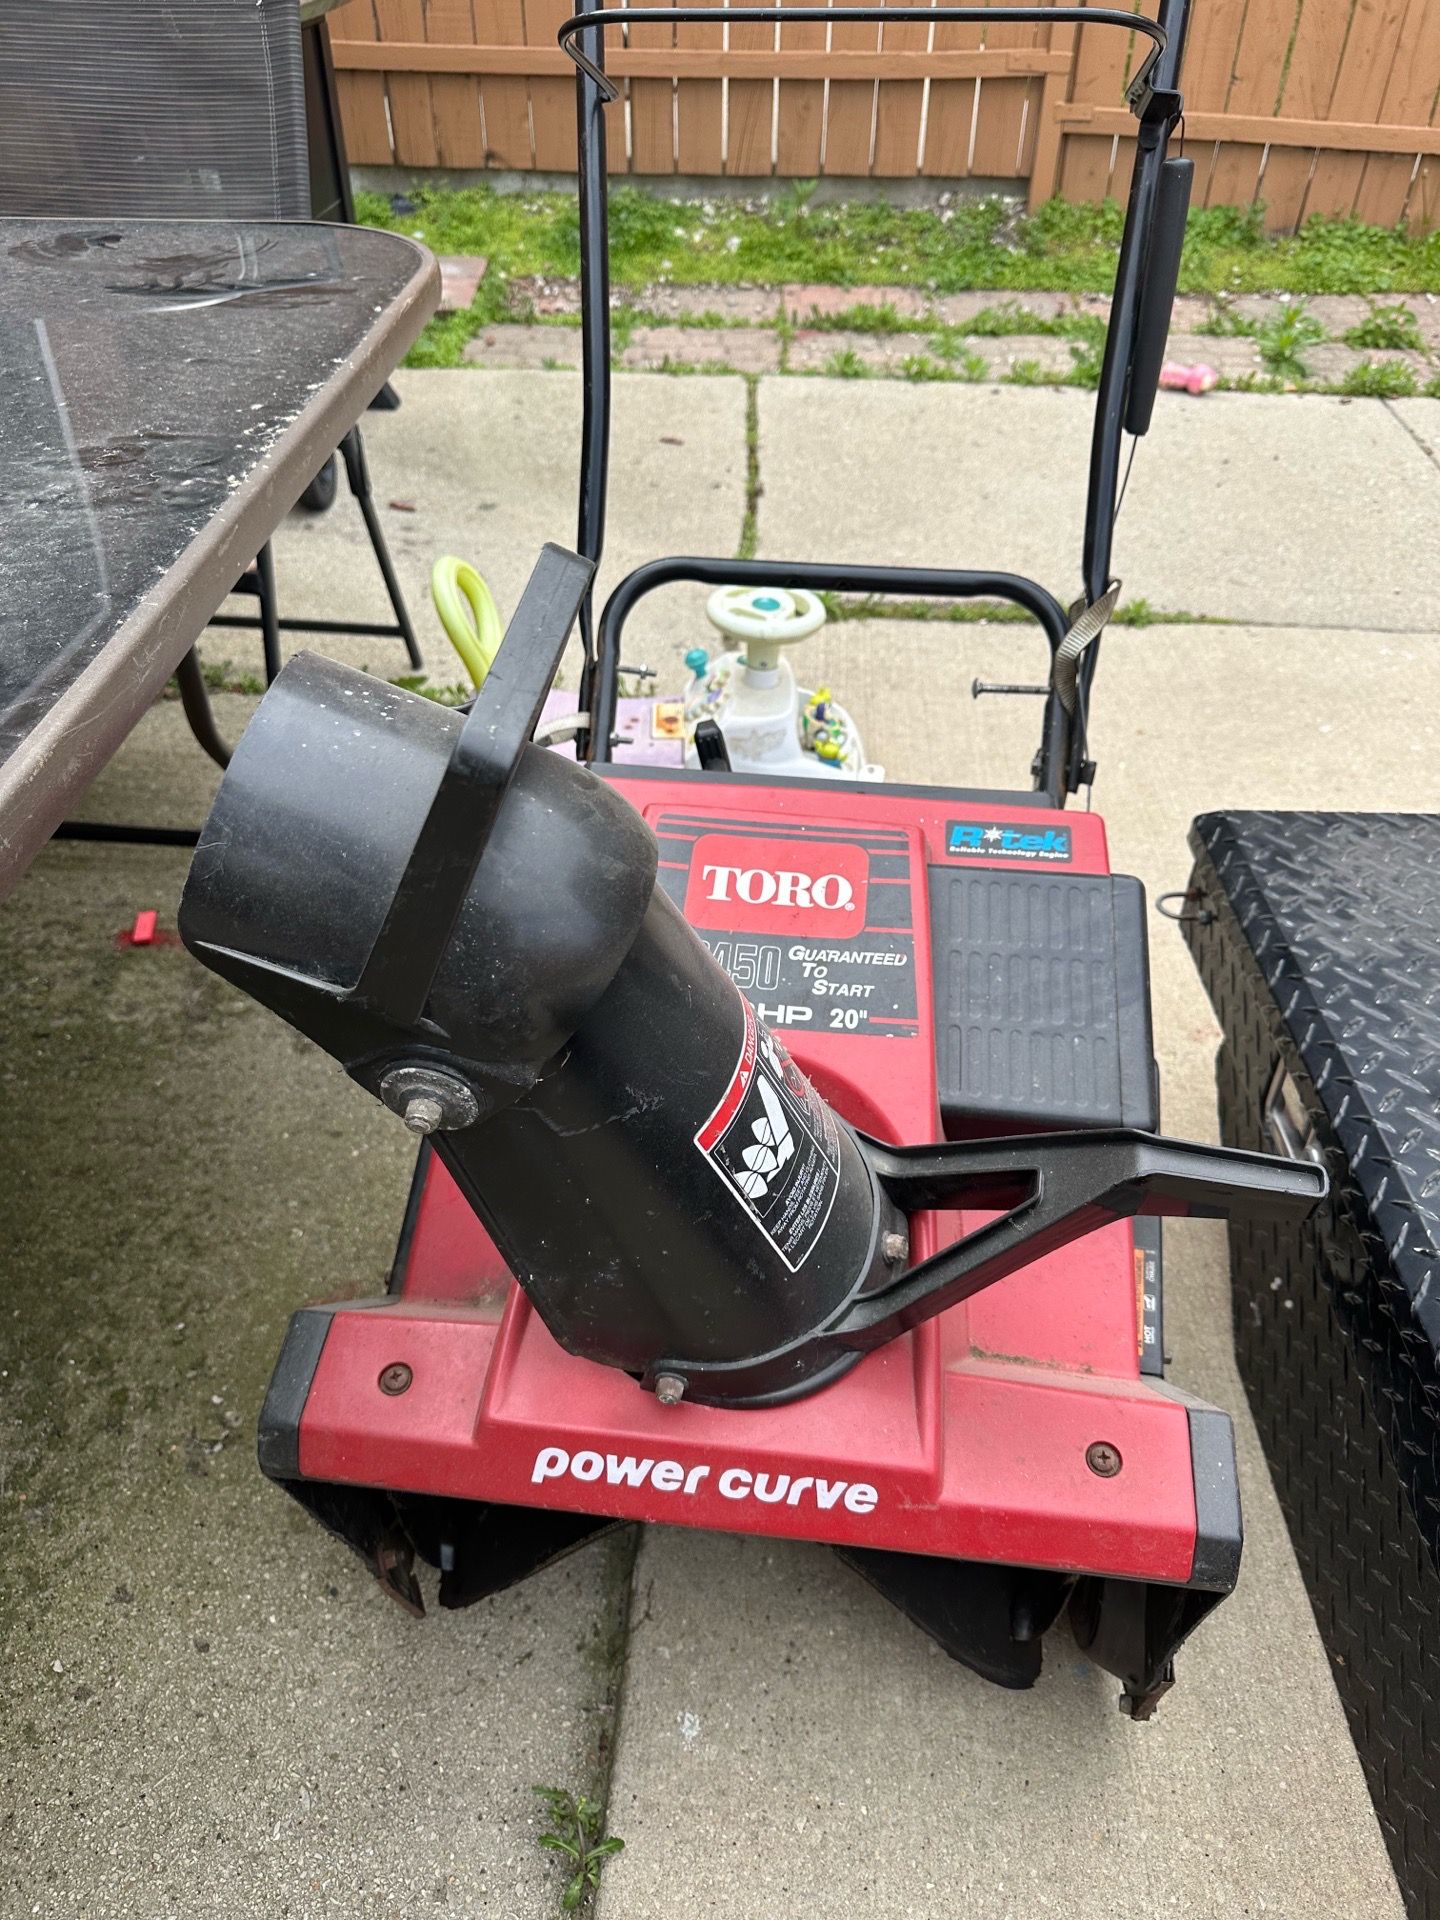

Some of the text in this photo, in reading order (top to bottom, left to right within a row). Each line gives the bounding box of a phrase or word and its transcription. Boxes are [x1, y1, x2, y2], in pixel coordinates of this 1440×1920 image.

[949, 846, 1069, 859] Reliable Technology Engine
[702, 940, 781, 990] 450
[788, 945, 907, 966] GUARANTEED
[812, 980, 875, 998] START
[750, 1002, 867, 1029] HP 20"
[531, 1447, 879, 1514] power curve
